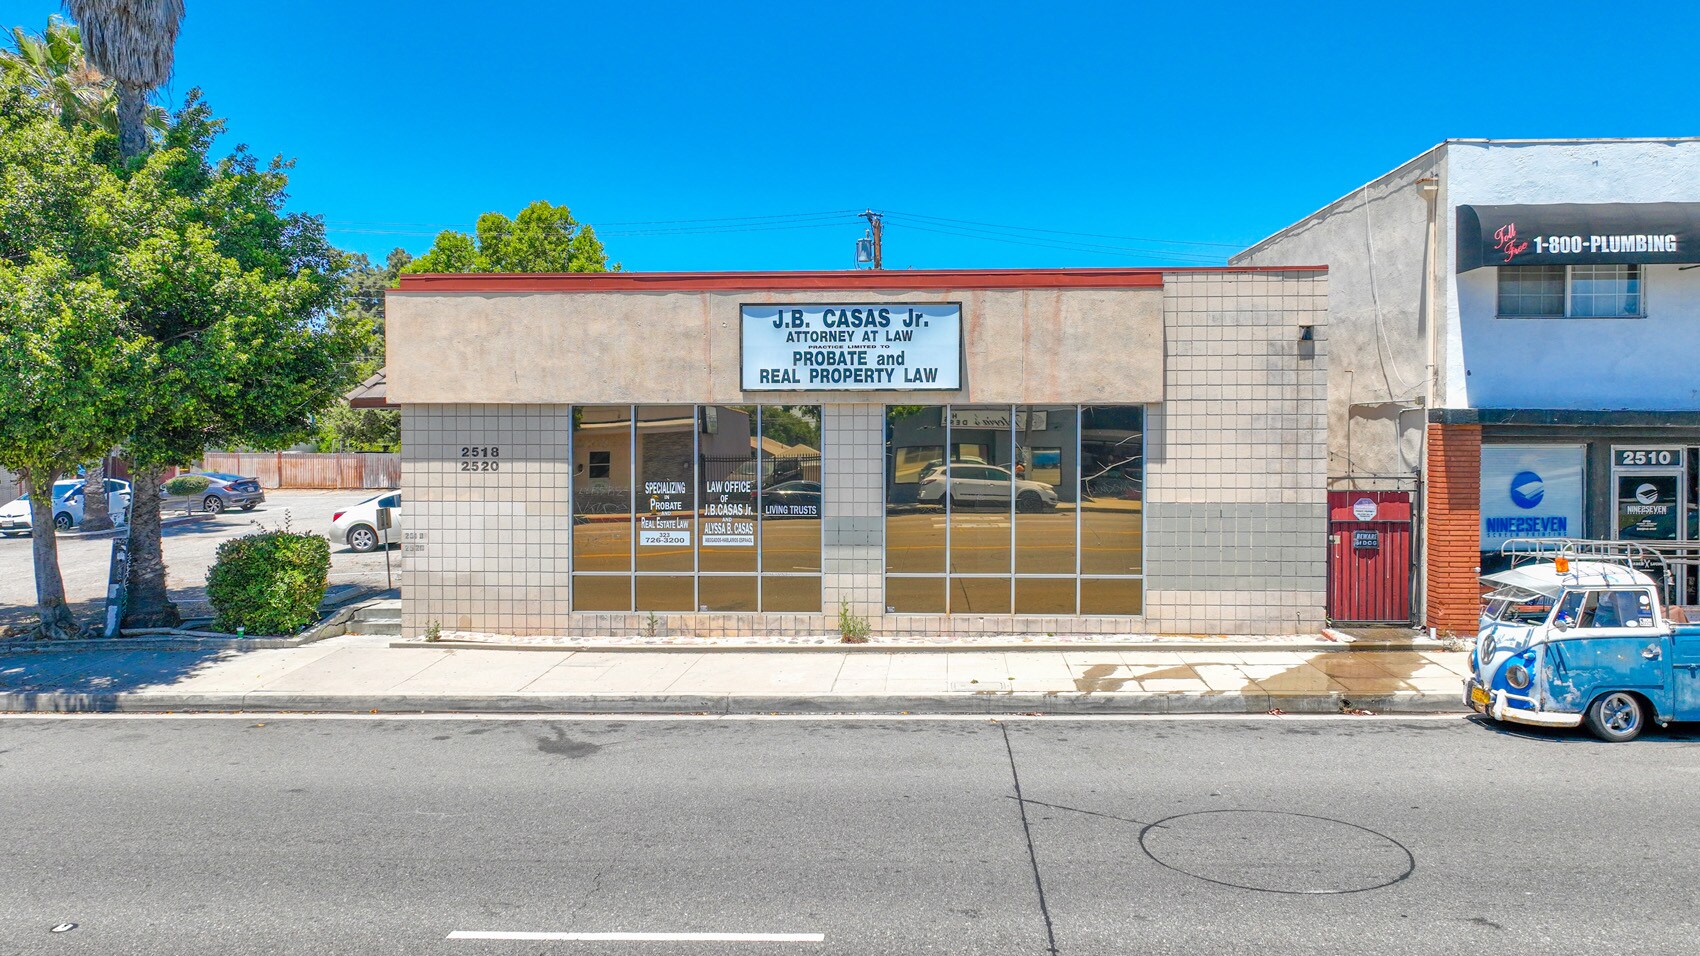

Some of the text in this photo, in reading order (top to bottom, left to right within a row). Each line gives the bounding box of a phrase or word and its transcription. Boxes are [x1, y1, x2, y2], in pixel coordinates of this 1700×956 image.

[1494, 223, 1516, 249] Toll
[1504, 238, 1528, 262] Free
[1533, 235, 1677, 254] 1-800-PLUMBING
[773, 308, 929, 329] J.B. CASAS Jr.
[786, 330, 914, 343] ATTORNEY AT LAW
[793, 350, 905, 366] PROBATE and
[760, 368, 938, 384] REAL PROPERTY LAW
[461, 447, 499, 458] 2518
[1622, 451, 1671, 465] 2510
[461, 461, 499, 471] 2520
[645, 482, 686, 494] SPECIALIZING
[706, 481, 751, 493] LAW OFFICE
[744, 504, 754, 515] Jr.
[765, 505, 817, 515] LIVING TRUSTS
[704, 523, 726, 534] ALYSSA
[734, 523, 754, 534] CASAS
